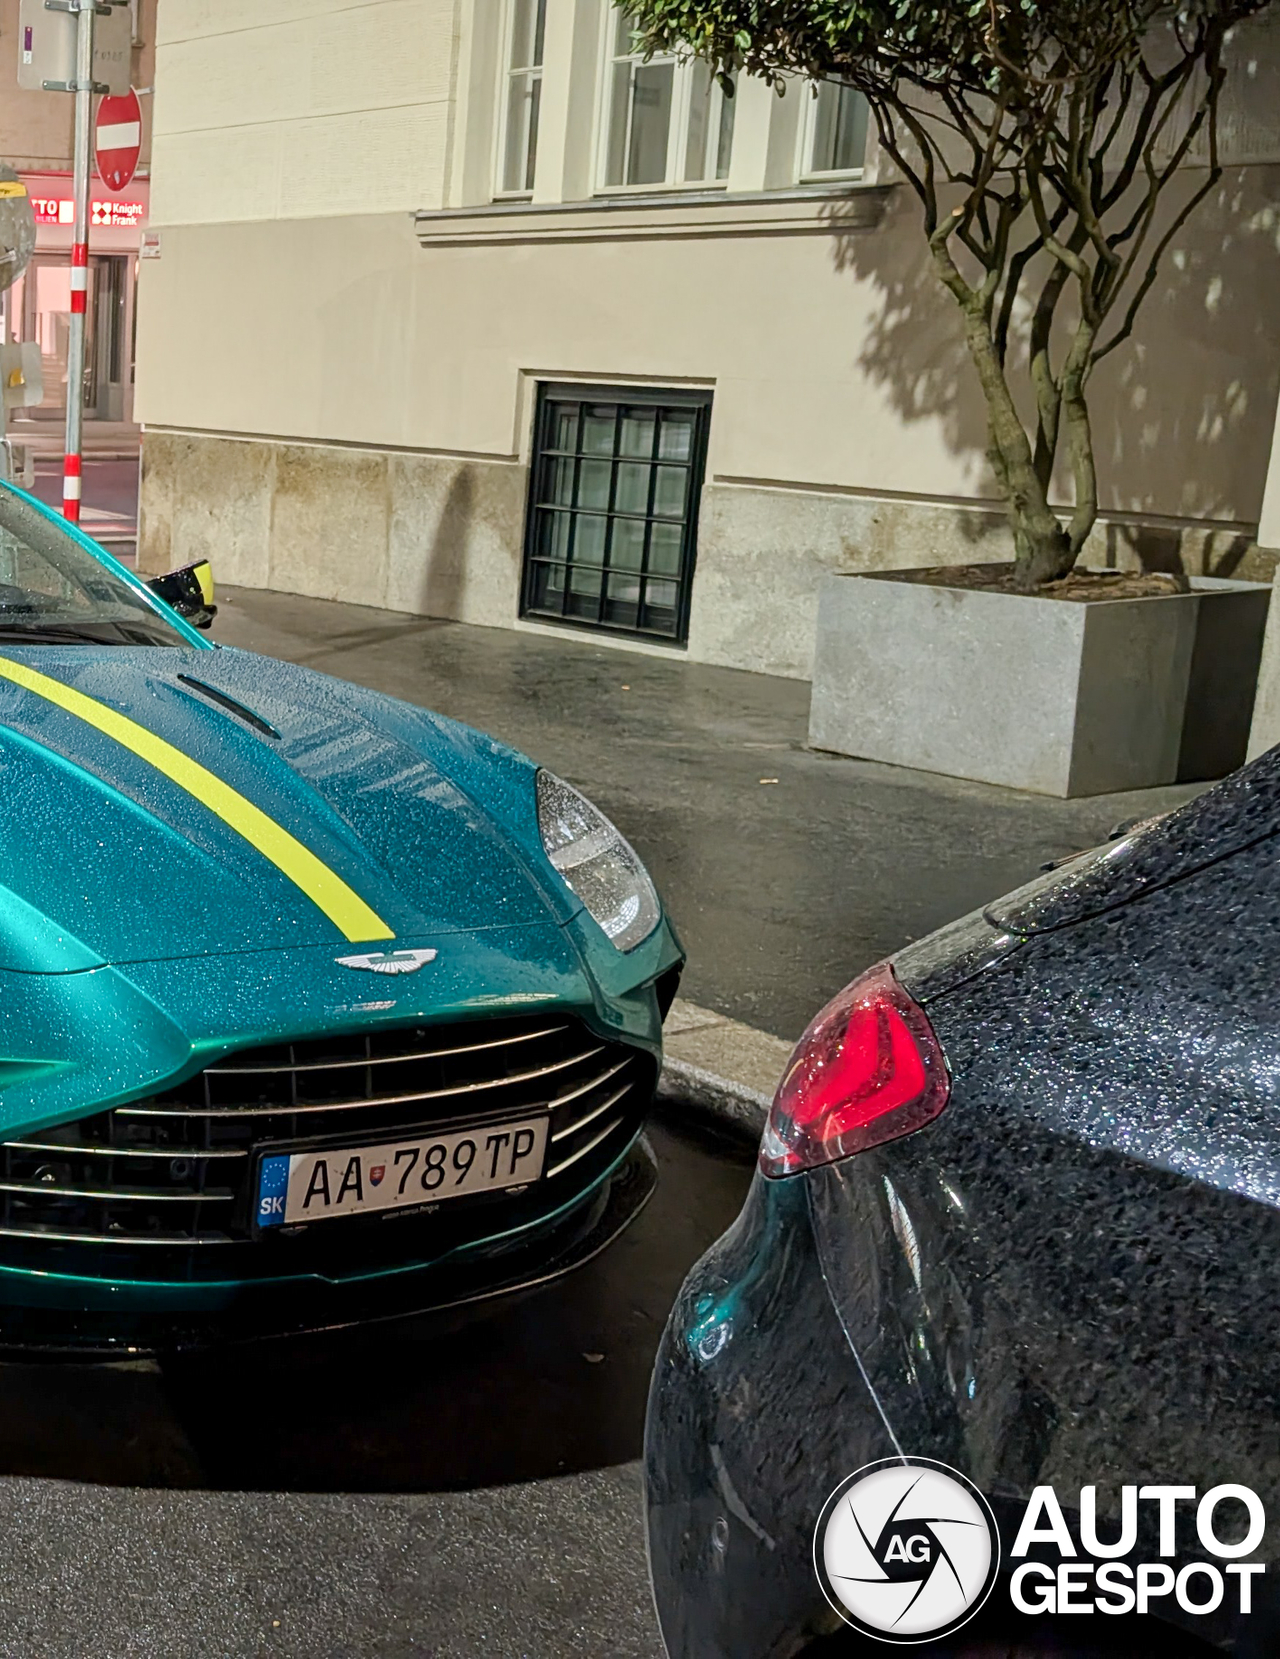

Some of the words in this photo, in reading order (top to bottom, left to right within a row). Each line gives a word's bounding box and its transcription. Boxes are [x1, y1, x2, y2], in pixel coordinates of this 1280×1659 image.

[112, 203, 143, 217] Knight
[112, 214, 137, 226] Frank
[302, 1156, 364, 1209] AA
[260, 1196, 284, 1215] SK
